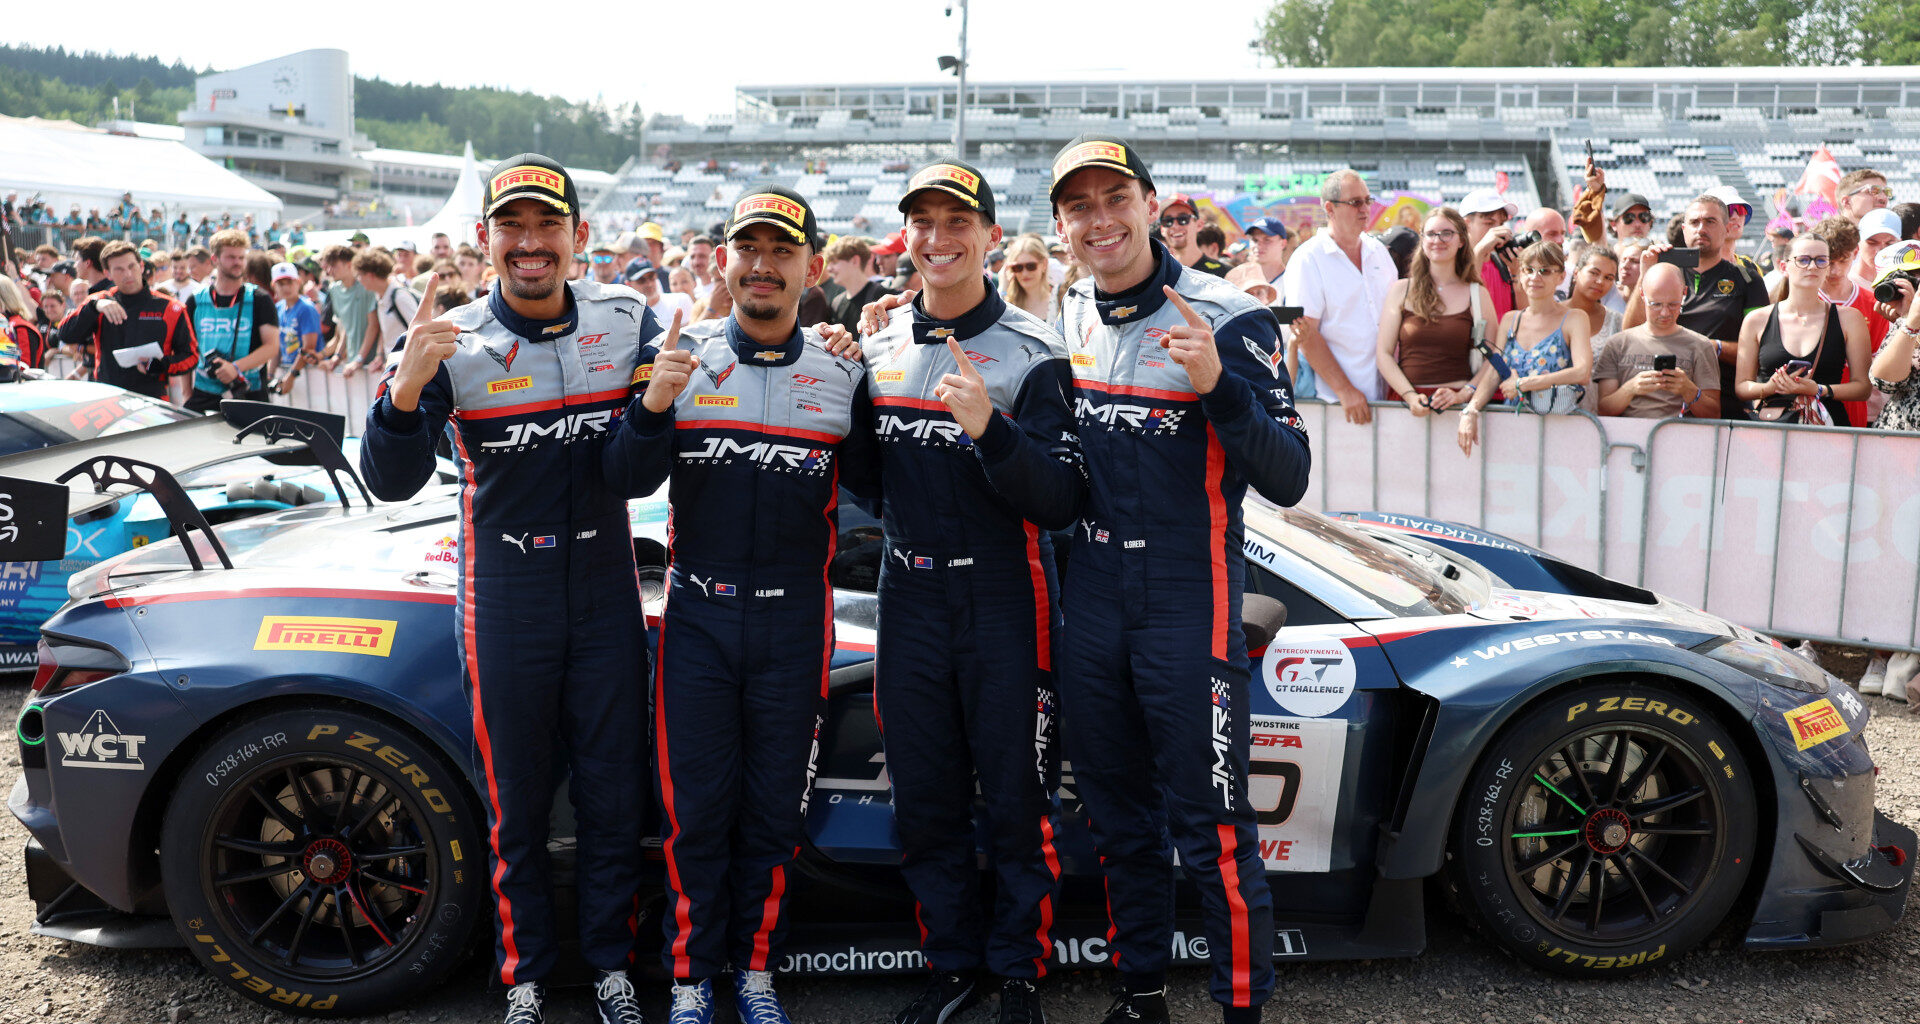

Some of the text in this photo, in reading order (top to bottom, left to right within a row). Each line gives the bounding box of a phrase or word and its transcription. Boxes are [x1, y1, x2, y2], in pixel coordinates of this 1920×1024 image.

[495, 169, 560, 193] PIRELLI
[739, 196, 801, 220] PIRELLI
[491, 378, 528, 392] PIRELLI
[699, 396, 735, 405] PIRELLI
[480, 409, 612, 448] JMR
[875, 414, 964, 442] JMR
[480, 443, 539, 454] JOHOR
[679, 437, 811, 468] JMR
[921, 440, 974, 452] RACIN
[443, 551, 459, 564] Bu
[267, 623, 383, 648] PIRELLI
[1473, 630, 1676, 660] WESTSTAR
[1274, 648, 1343, 656] INTERCONTINENTAL
[1275, 685, 1345, 695] GT CHALLENGE
[1566, 702, 1588, 722] P
[1793, 706, 1842, 741] PIRELLI
[306, 724, 339, 740] P
[1249, 720, 1300, 730] OWDSTRIKE
[57, 732, 146, 762] WCT
[1212, 704, 1230, 811] JMR
[1258, 839, 1293, 861] WE
[778, 946, 928, 973] onochrom
[1547, 943, 1667, 969] PIRELLI
[195, 934, 339, 1010] PIRELLI
